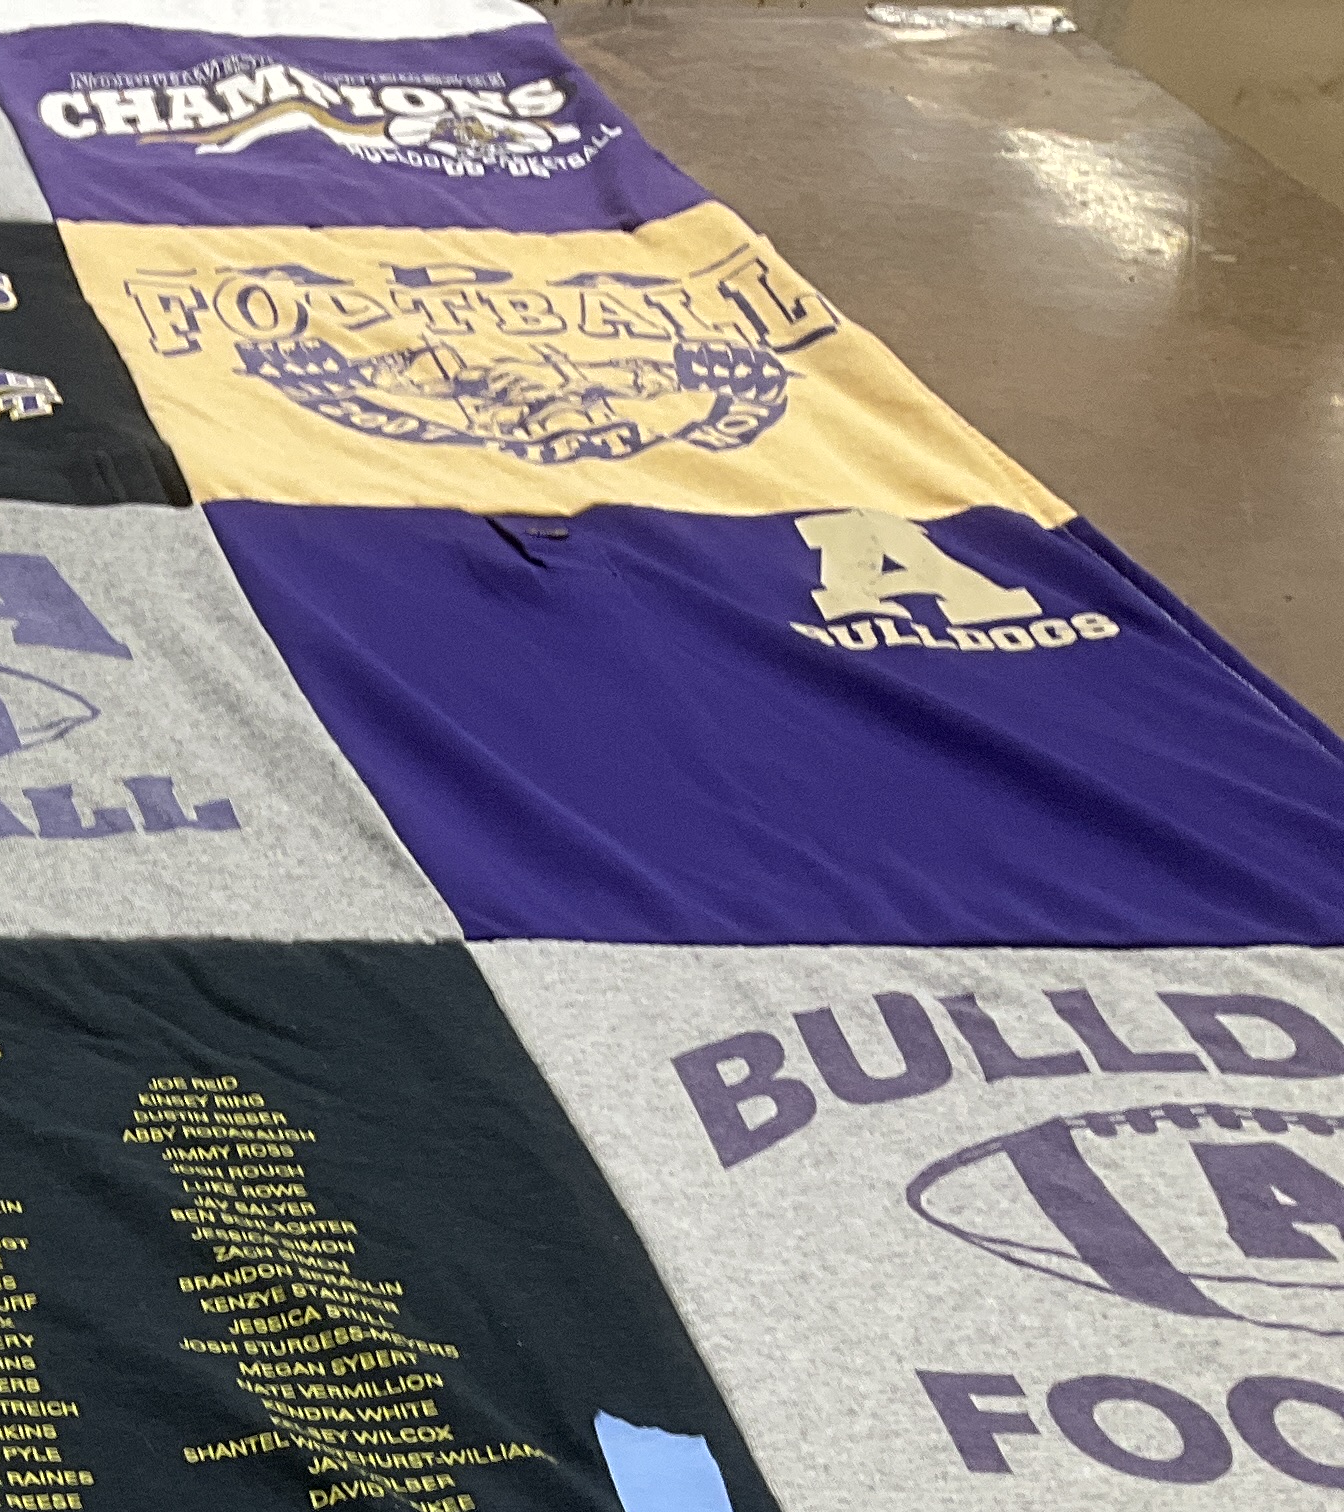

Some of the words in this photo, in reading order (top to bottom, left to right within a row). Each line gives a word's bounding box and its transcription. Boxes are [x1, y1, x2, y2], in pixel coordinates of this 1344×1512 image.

[794, 508, 1043, 625] A
[671, 987, 1344, 1169] BULLD
[122, 1125, 176, 1143] ABBY
[162, 1144, 230, 1161] JIMMY
[228, 1164, 305, 1180] ROUGH
[242, 1184, 308, 1198] ROWE
[170, 1208, 216, 1223] BEN
[178, 1263, 292, 1292] BRANDON
[228, 1305, 322, 1336] JESSICA
[179, 1337, 239, 1354] JOSH
[238, 1360, 326, 1378] MEGAN
[300, 1372, 444, 1400] VERMILLION
[356, 1399, 439, 1422] WHITE
[353, 1424, 454, 1445] WILCOX
[915, 1368, 1344, 1491] FOO
[3, 1446, 62, 1462] PYLE
[183, 1430, 289, 1464] SHANTEL
[6, 1470, 94, 1487] RAINES
[6, 1492, 83, 1511] REESE
[309, 1481, 385, 1510] DAVID
